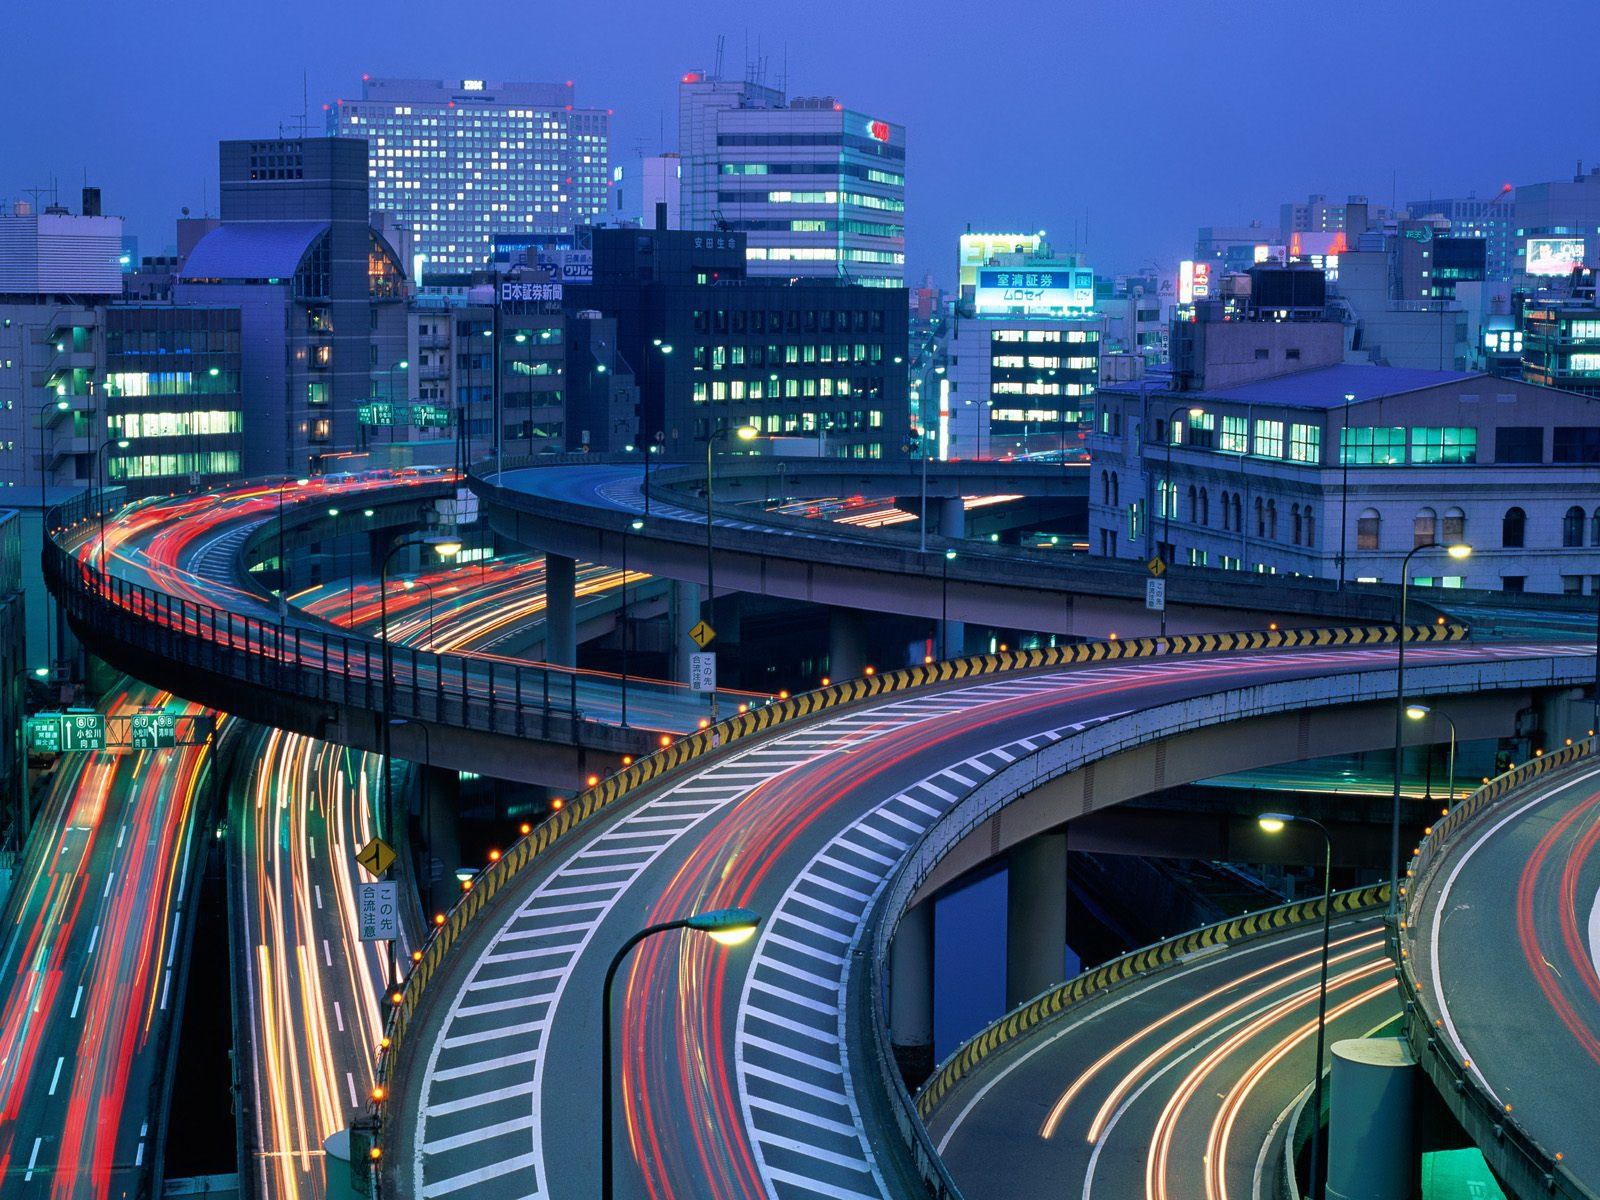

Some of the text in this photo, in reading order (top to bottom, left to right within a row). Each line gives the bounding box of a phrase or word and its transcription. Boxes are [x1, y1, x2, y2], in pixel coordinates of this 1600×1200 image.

[694, 237, 736, 249] 安田生命
[997, 273, 1053, 287] 室清証券
[502, 283, 563, 301] 日本証券新聞
[1004, 289, 1044, 301] ムロセイ
[704, 656, 712, 686] この先
[77, 730, 102, 738] 小松川
[133, 729, 149, 738] 小松川
[81, 740, 98, 749] 向島
[363, 886, 376, 938] 合流注意
[381, 889, 393, 930] この先
